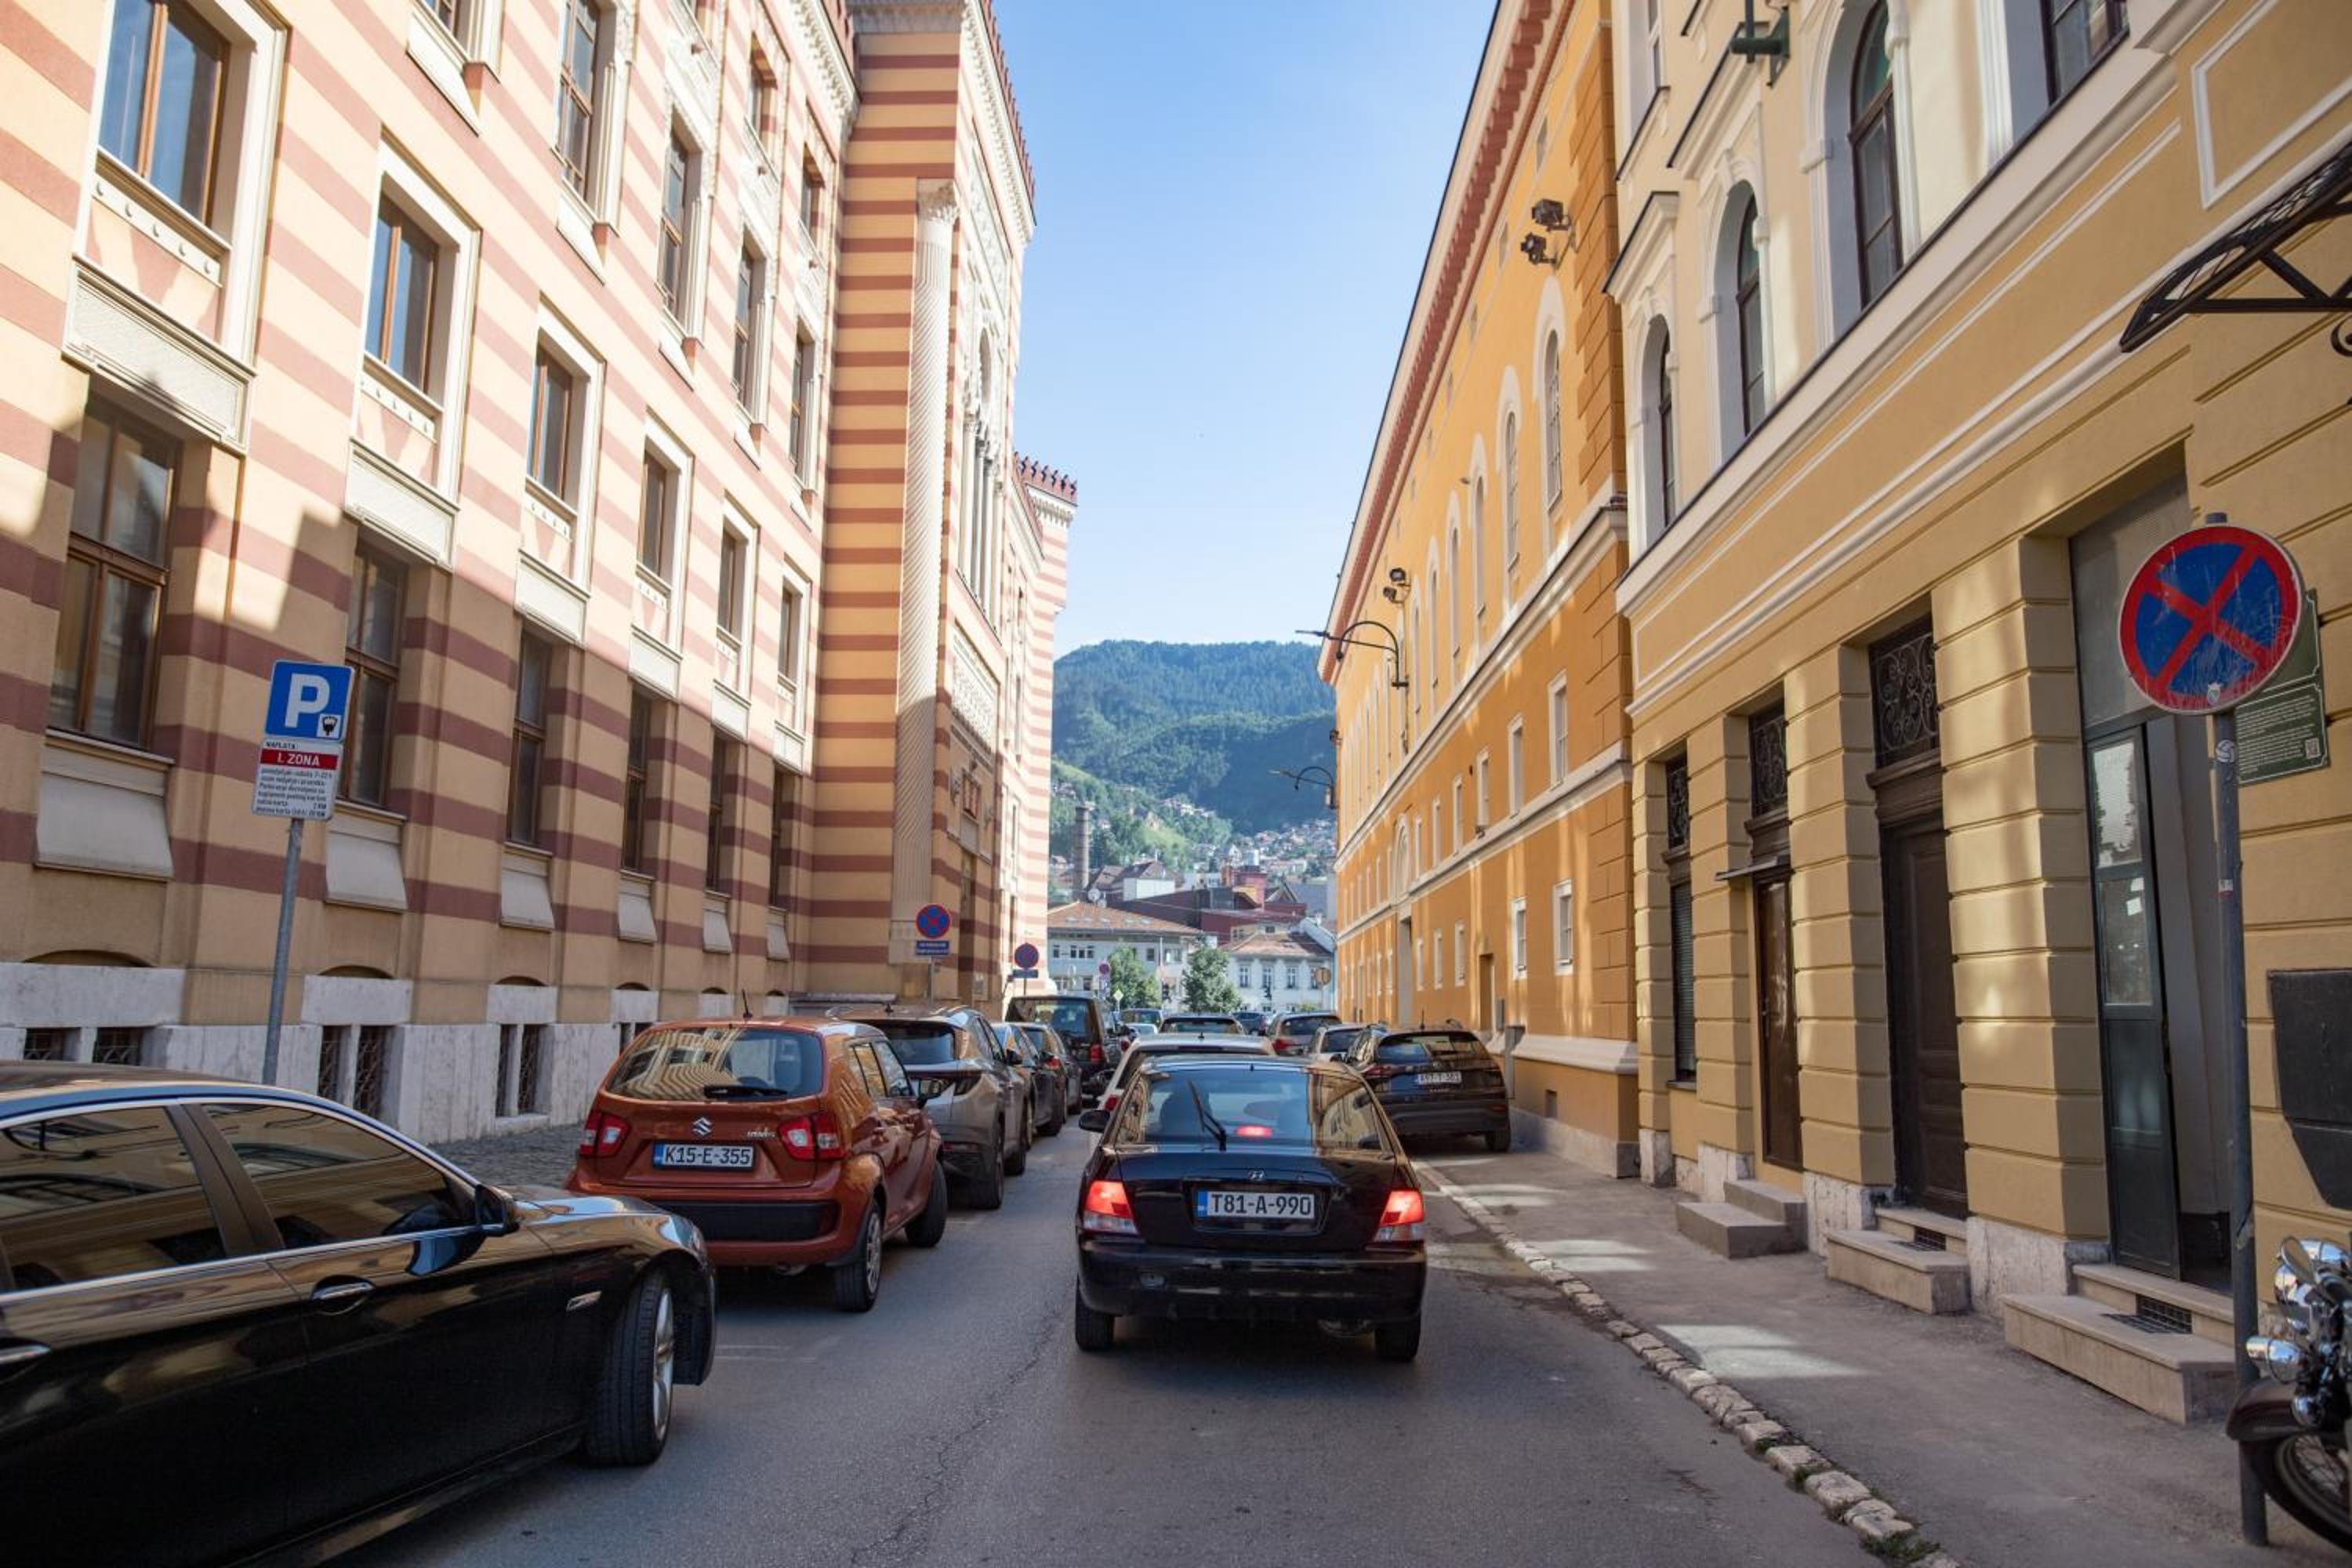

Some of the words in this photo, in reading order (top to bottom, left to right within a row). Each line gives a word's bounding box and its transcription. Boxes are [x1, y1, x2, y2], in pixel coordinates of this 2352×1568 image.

[285, 673, 330, 728] P
[287, 753, 320, 767] ZONA
[665, 1146, 751, 1165] K15-E-355
[1210, 1194, 1311, 1215] T81-A-990
